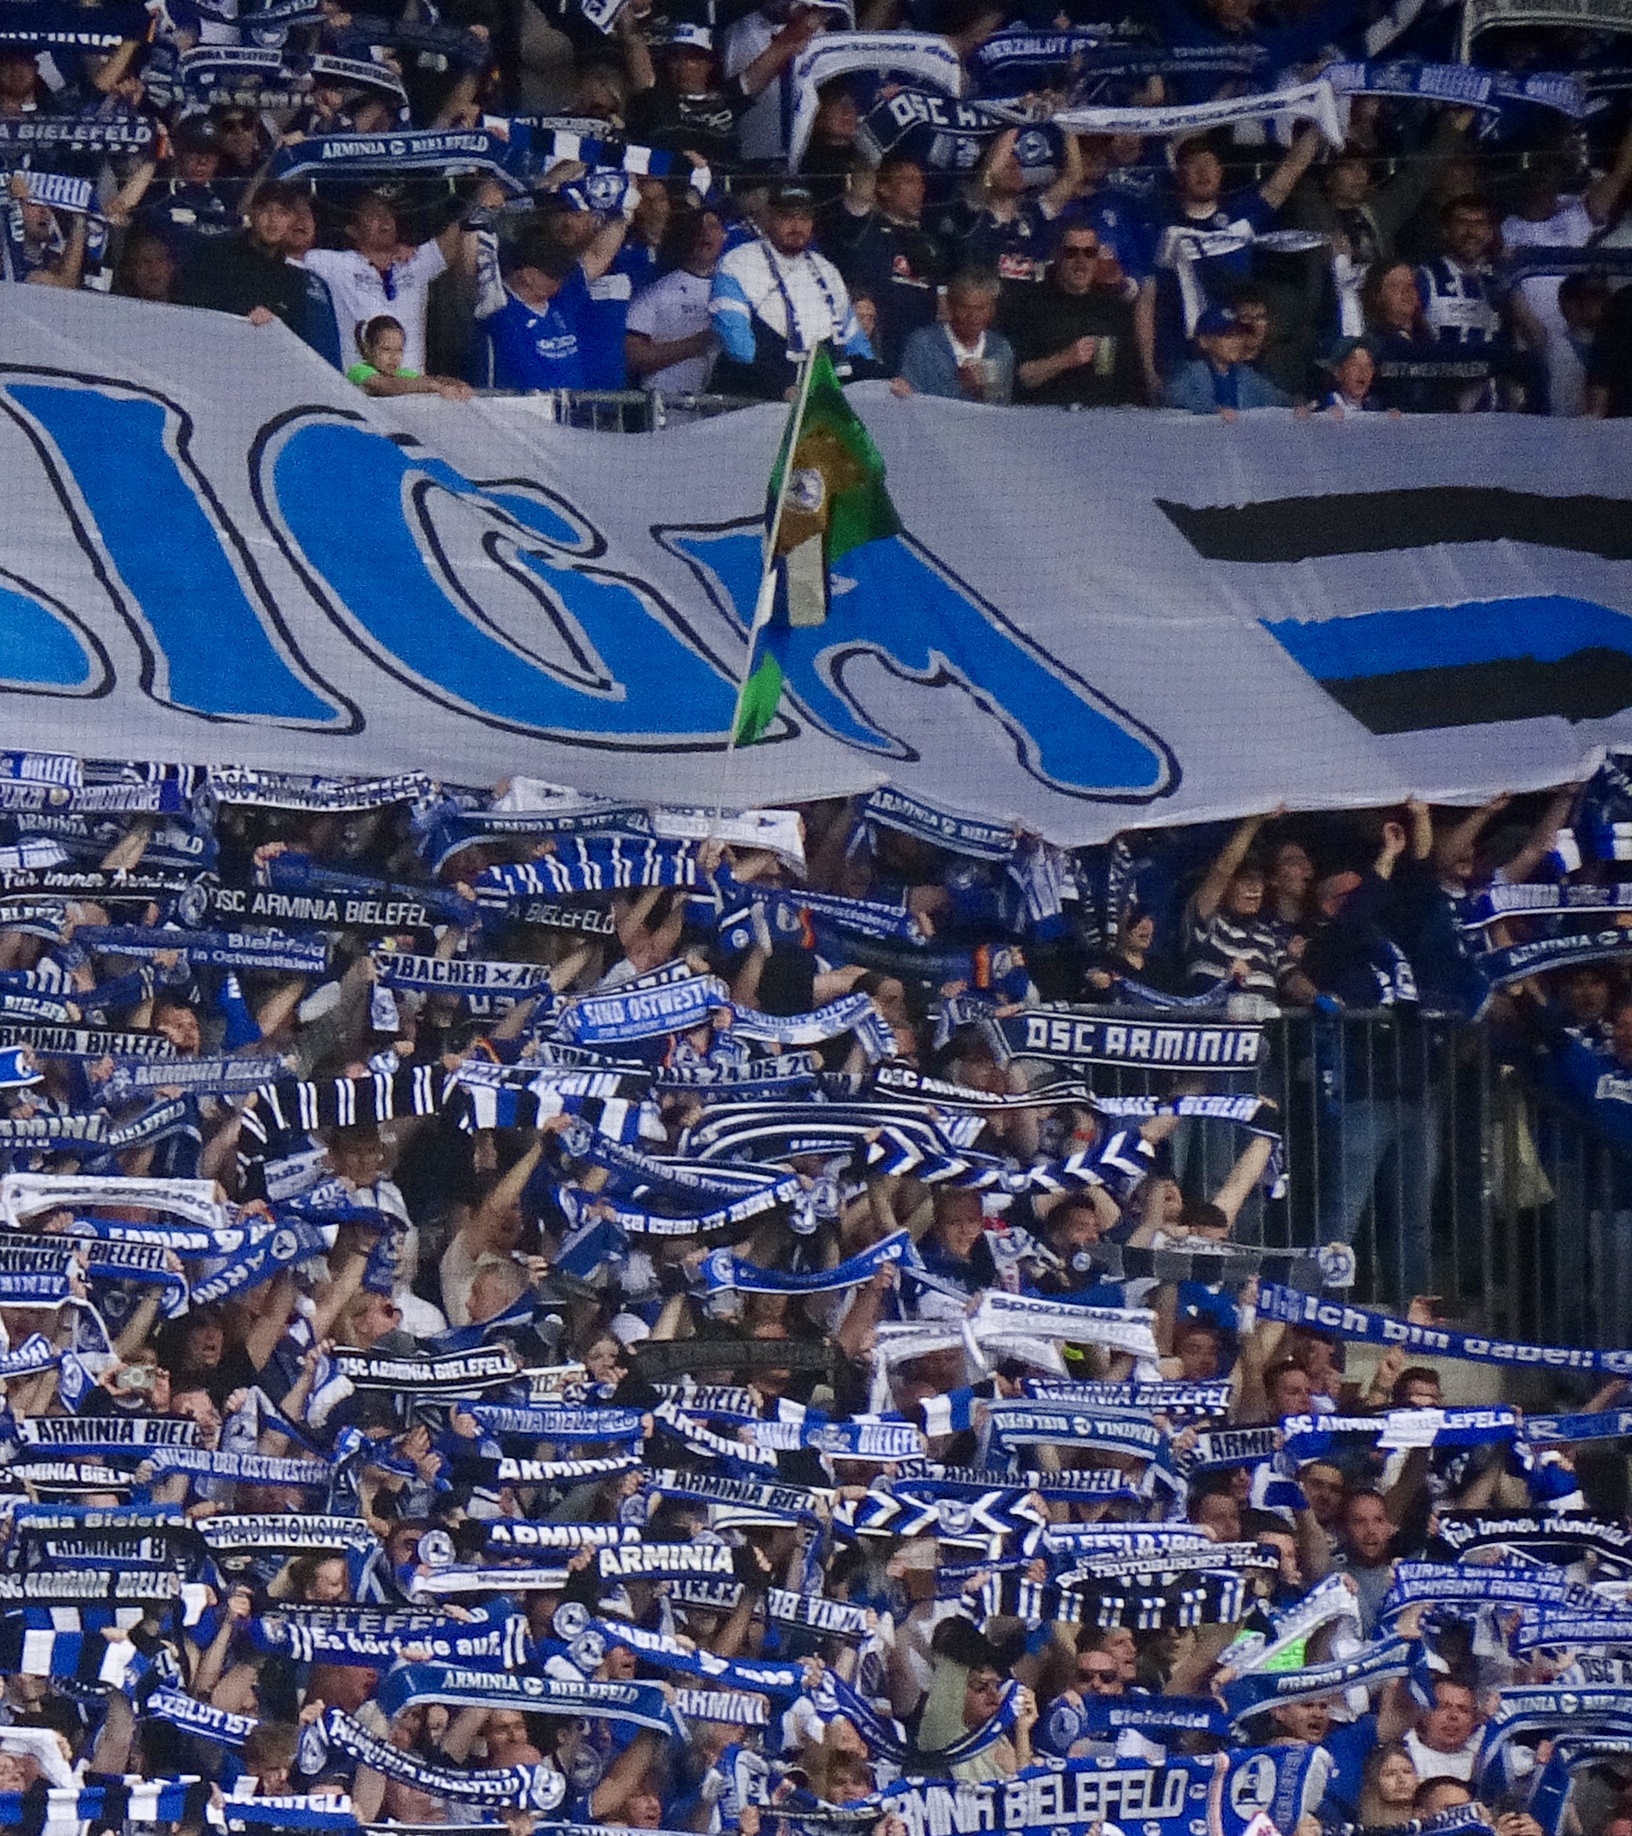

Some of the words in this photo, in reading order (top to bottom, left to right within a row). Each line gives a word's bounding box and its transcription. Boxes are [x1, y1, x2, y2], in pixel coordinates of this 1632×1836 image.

[16, 119, 152, 144] BIELEFELD
[321, 140, 387, 161] ARMINIA
[251, 892, 339, 922] ARMINIA
[1025, 1020, 1095, 1052] DSC
[1101, 1025, 1261, 1063] ARMINIA
[1302, 1297, 1369, 1334] Ich
[1381, 1317, 1452, 1350] bin
[370, 1357, 433, 1382] ARMINIA
[36, 1418, 135, 1443] ARMINIA
[490, 1523, 641, 1546] ARMINIA
[441, 1670, 520, 1691] ARMINIA
[550, 1680, 639, 1700] BIELEFELD
[1108, 1707, 1212, 1730] Bielefeld
[1002, 1767, 1189, 1828] BIELEFELD
